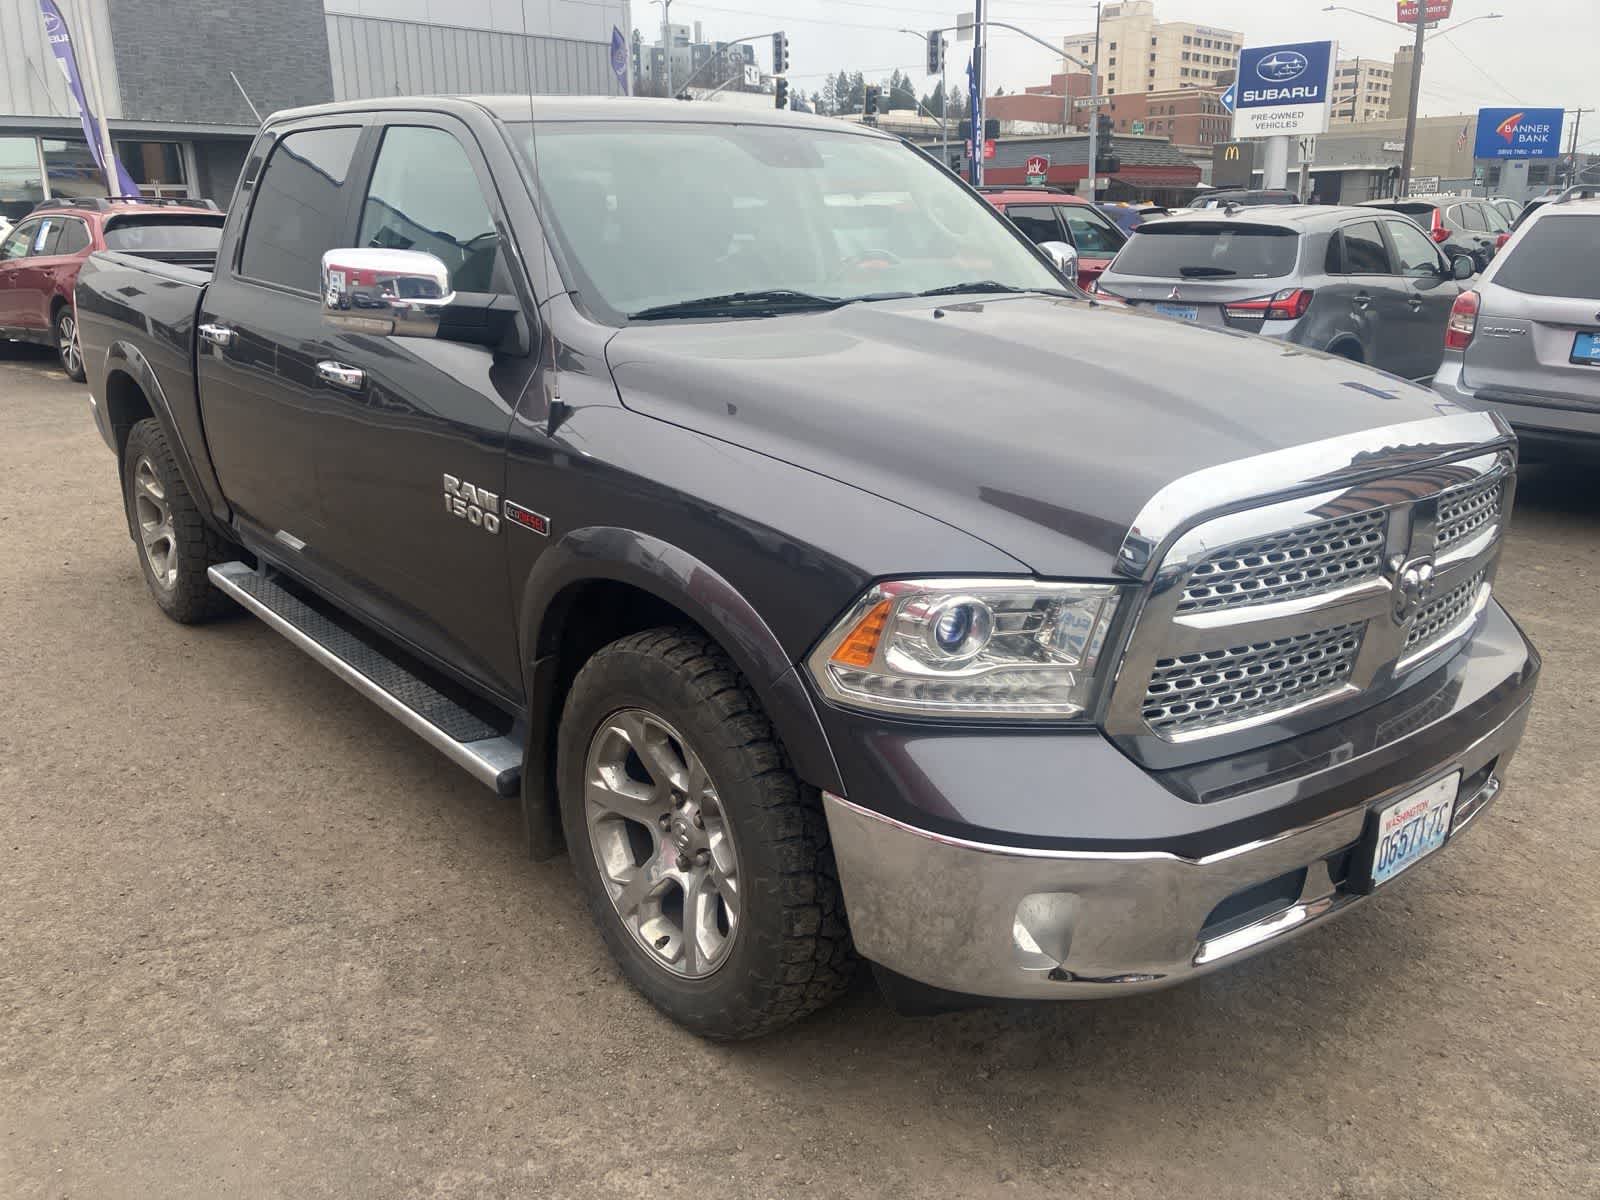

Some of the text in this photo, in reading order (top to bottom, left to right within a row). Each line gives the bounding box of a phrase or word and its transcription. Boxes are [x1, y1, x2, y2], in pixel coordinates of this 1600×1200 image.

[1243, 85, 1318, 102] SUBARU
[1251, 111, 1304, 121] PRE-OWNED
[1255, 120, 1298, 130] VEHICLES
[1504, 124, 1550, 134] BANNER
[1519, 134, 1549, 143] BANK
[443, 472, 500, 516] RAM
[443, 492, 501, 535] 1500
[1385, 799, 1430, 830] WASHINGTON
